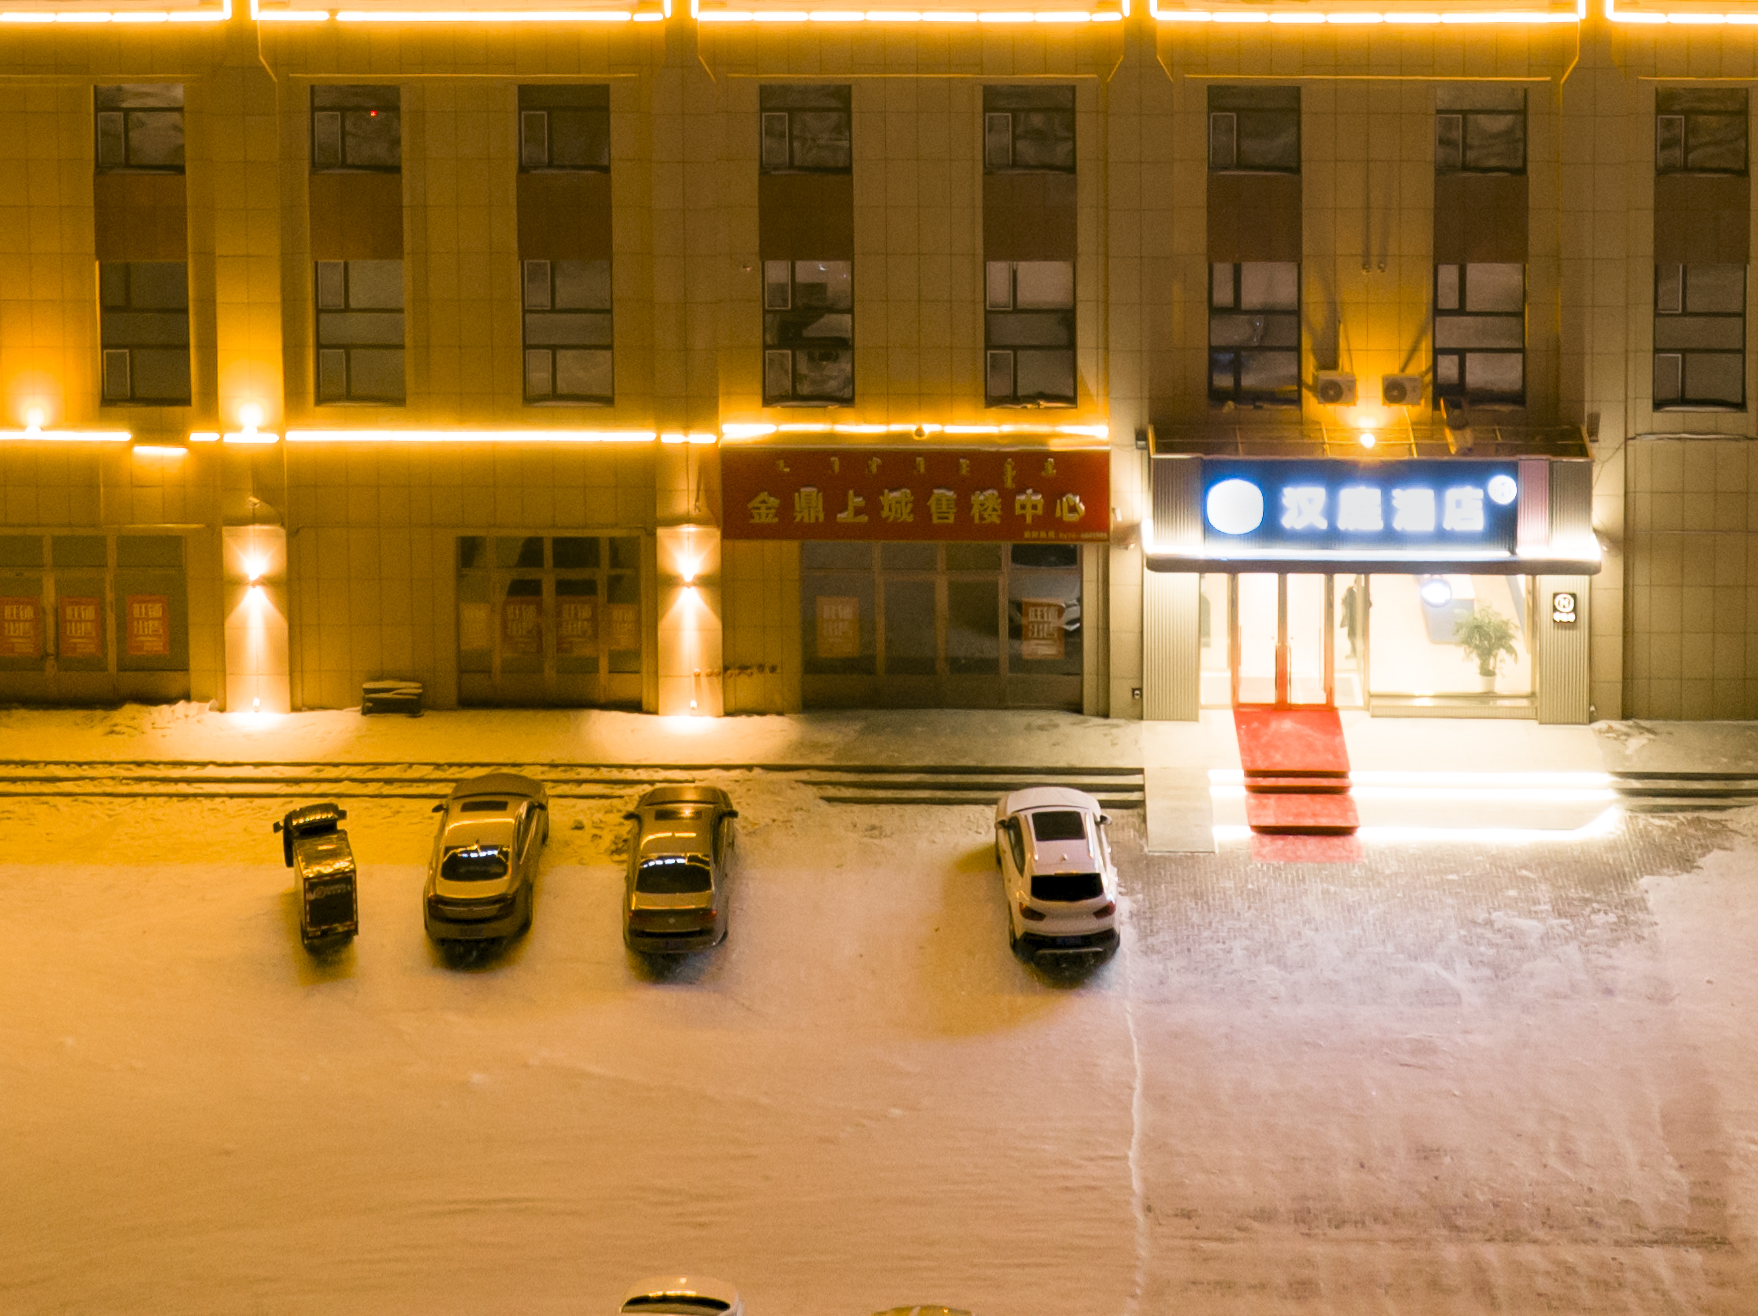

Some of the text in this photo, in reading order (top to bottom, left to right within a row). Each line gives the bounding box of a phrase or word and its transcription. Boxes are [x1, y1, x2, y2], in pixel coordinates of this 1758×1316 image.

[747, 485, 1087, 525] 金鼎上城售楼中心
[1281, 486, 1485, 531] 汉庭酒店
